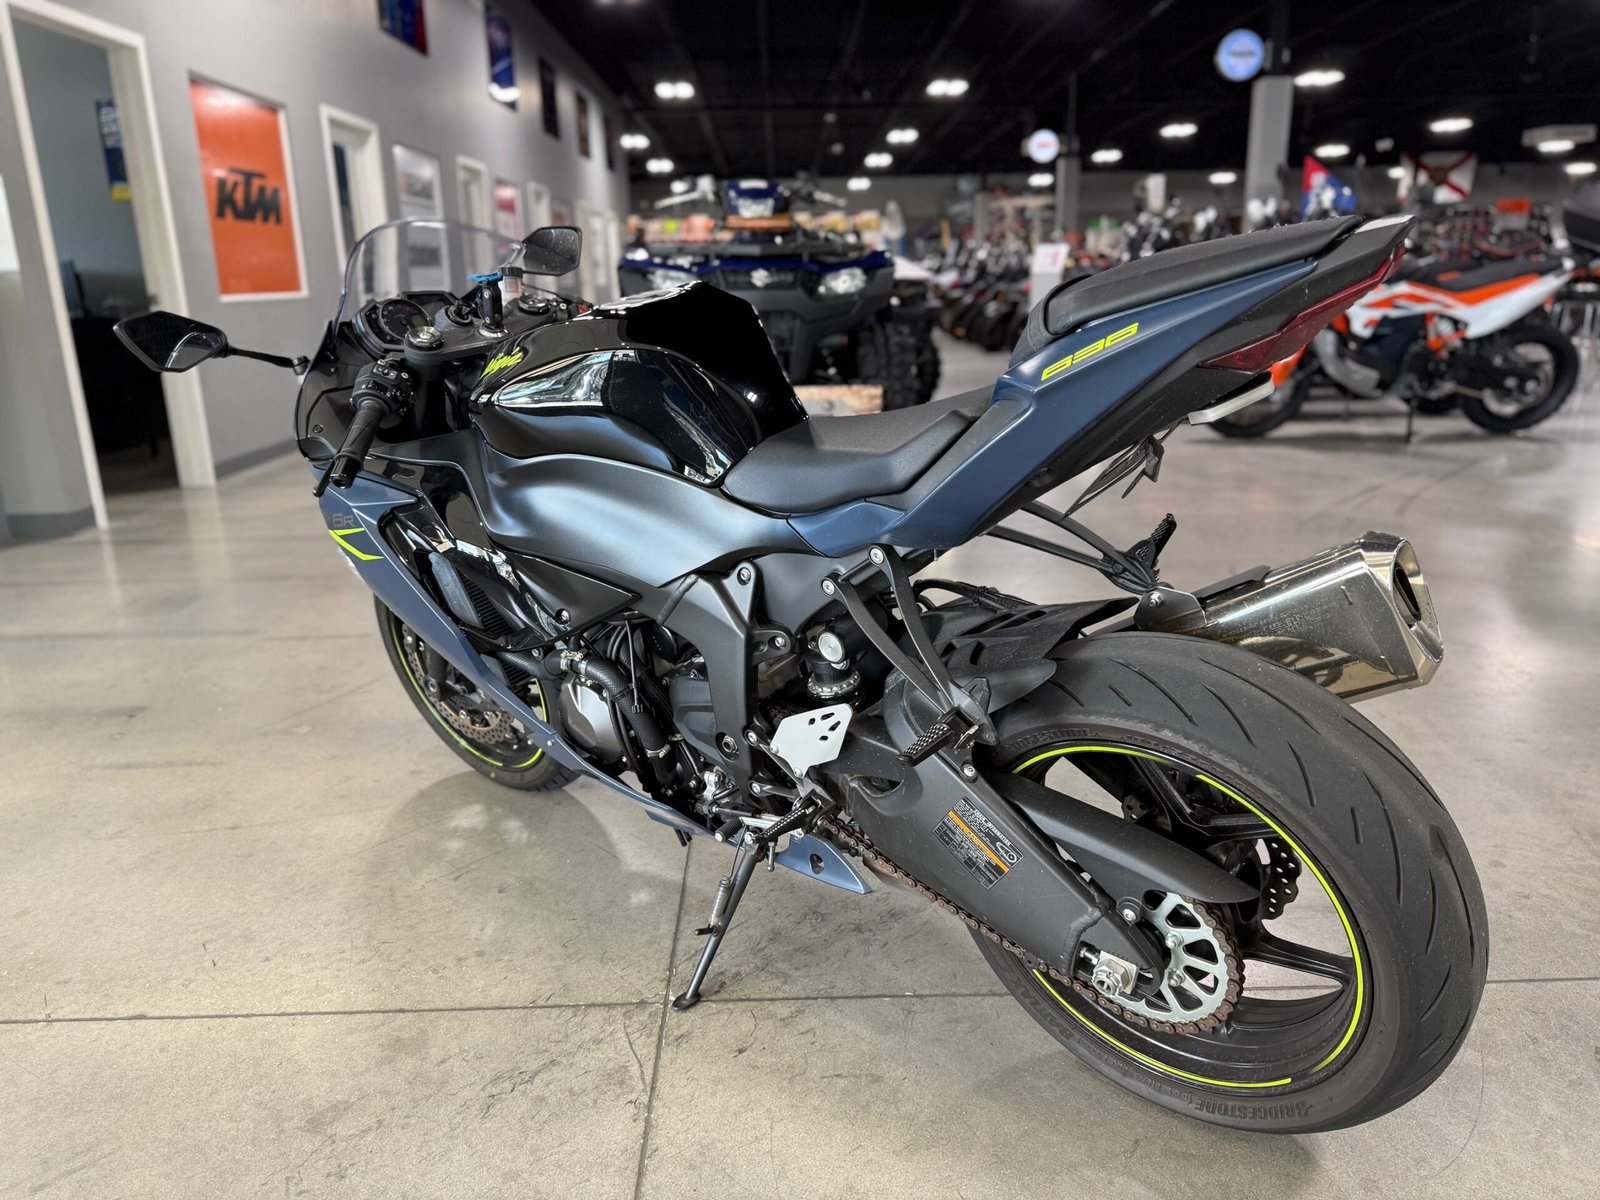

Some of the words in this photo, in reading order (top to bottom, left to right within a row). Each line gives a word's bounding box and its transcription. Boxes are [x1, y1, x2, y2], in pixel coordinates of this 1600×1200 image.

[216, 166, 282, 226] KTM
[1040, 322, 1139, 381] 636
[1194, 1098, 1312, 1121] BRIDGESTONE
